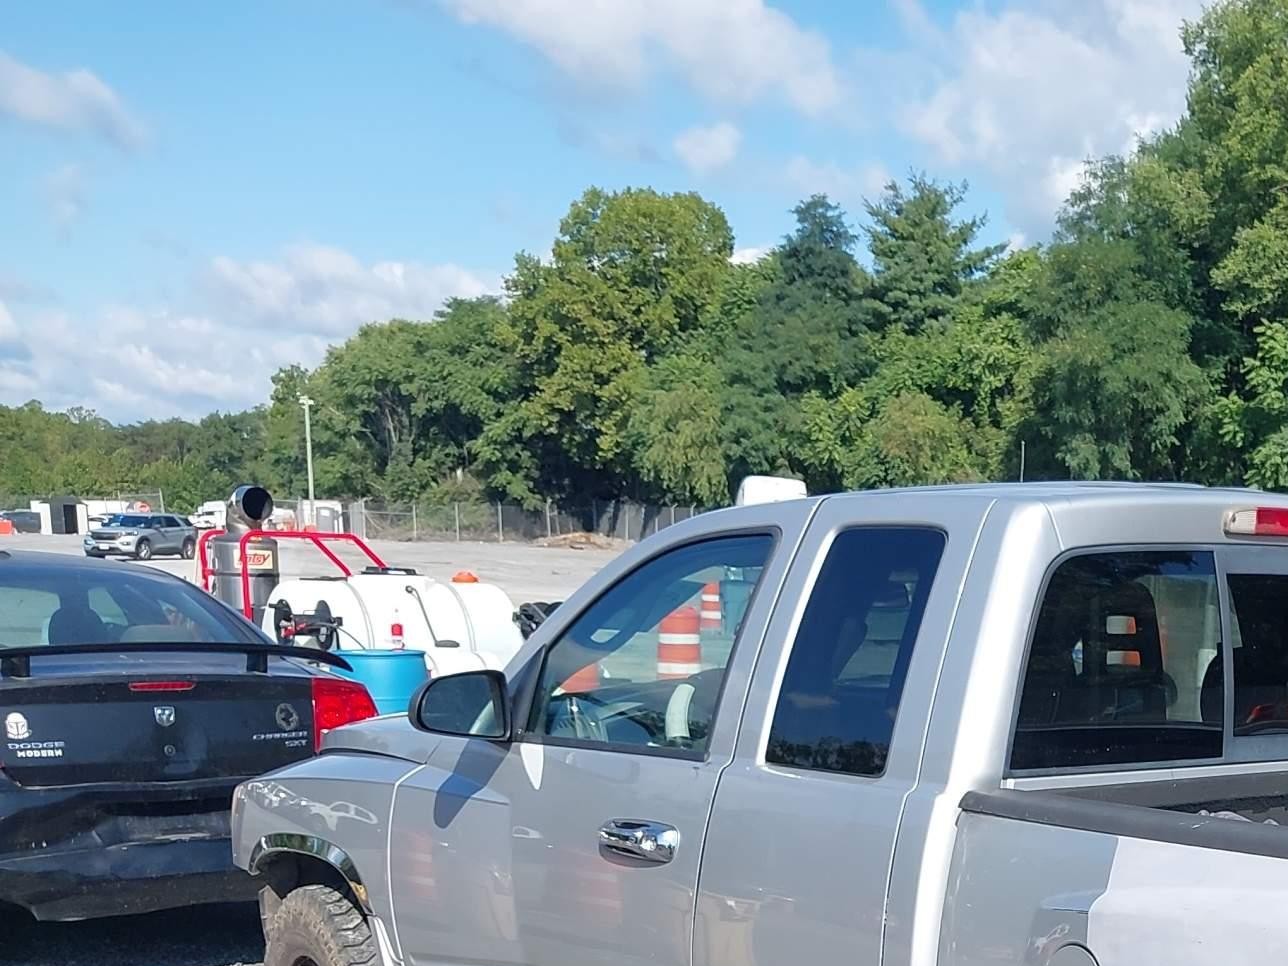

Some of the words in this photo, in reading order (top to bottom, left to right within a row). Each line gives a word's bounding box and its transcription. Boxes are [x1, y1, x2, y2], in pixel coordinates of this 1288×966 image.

[252, 730, 308, 741] CHARGER
[7, 741, 65, 750] DODGE
[284, 740, 308, 748] SXT
[16, 749, 63, 758] MODERN
